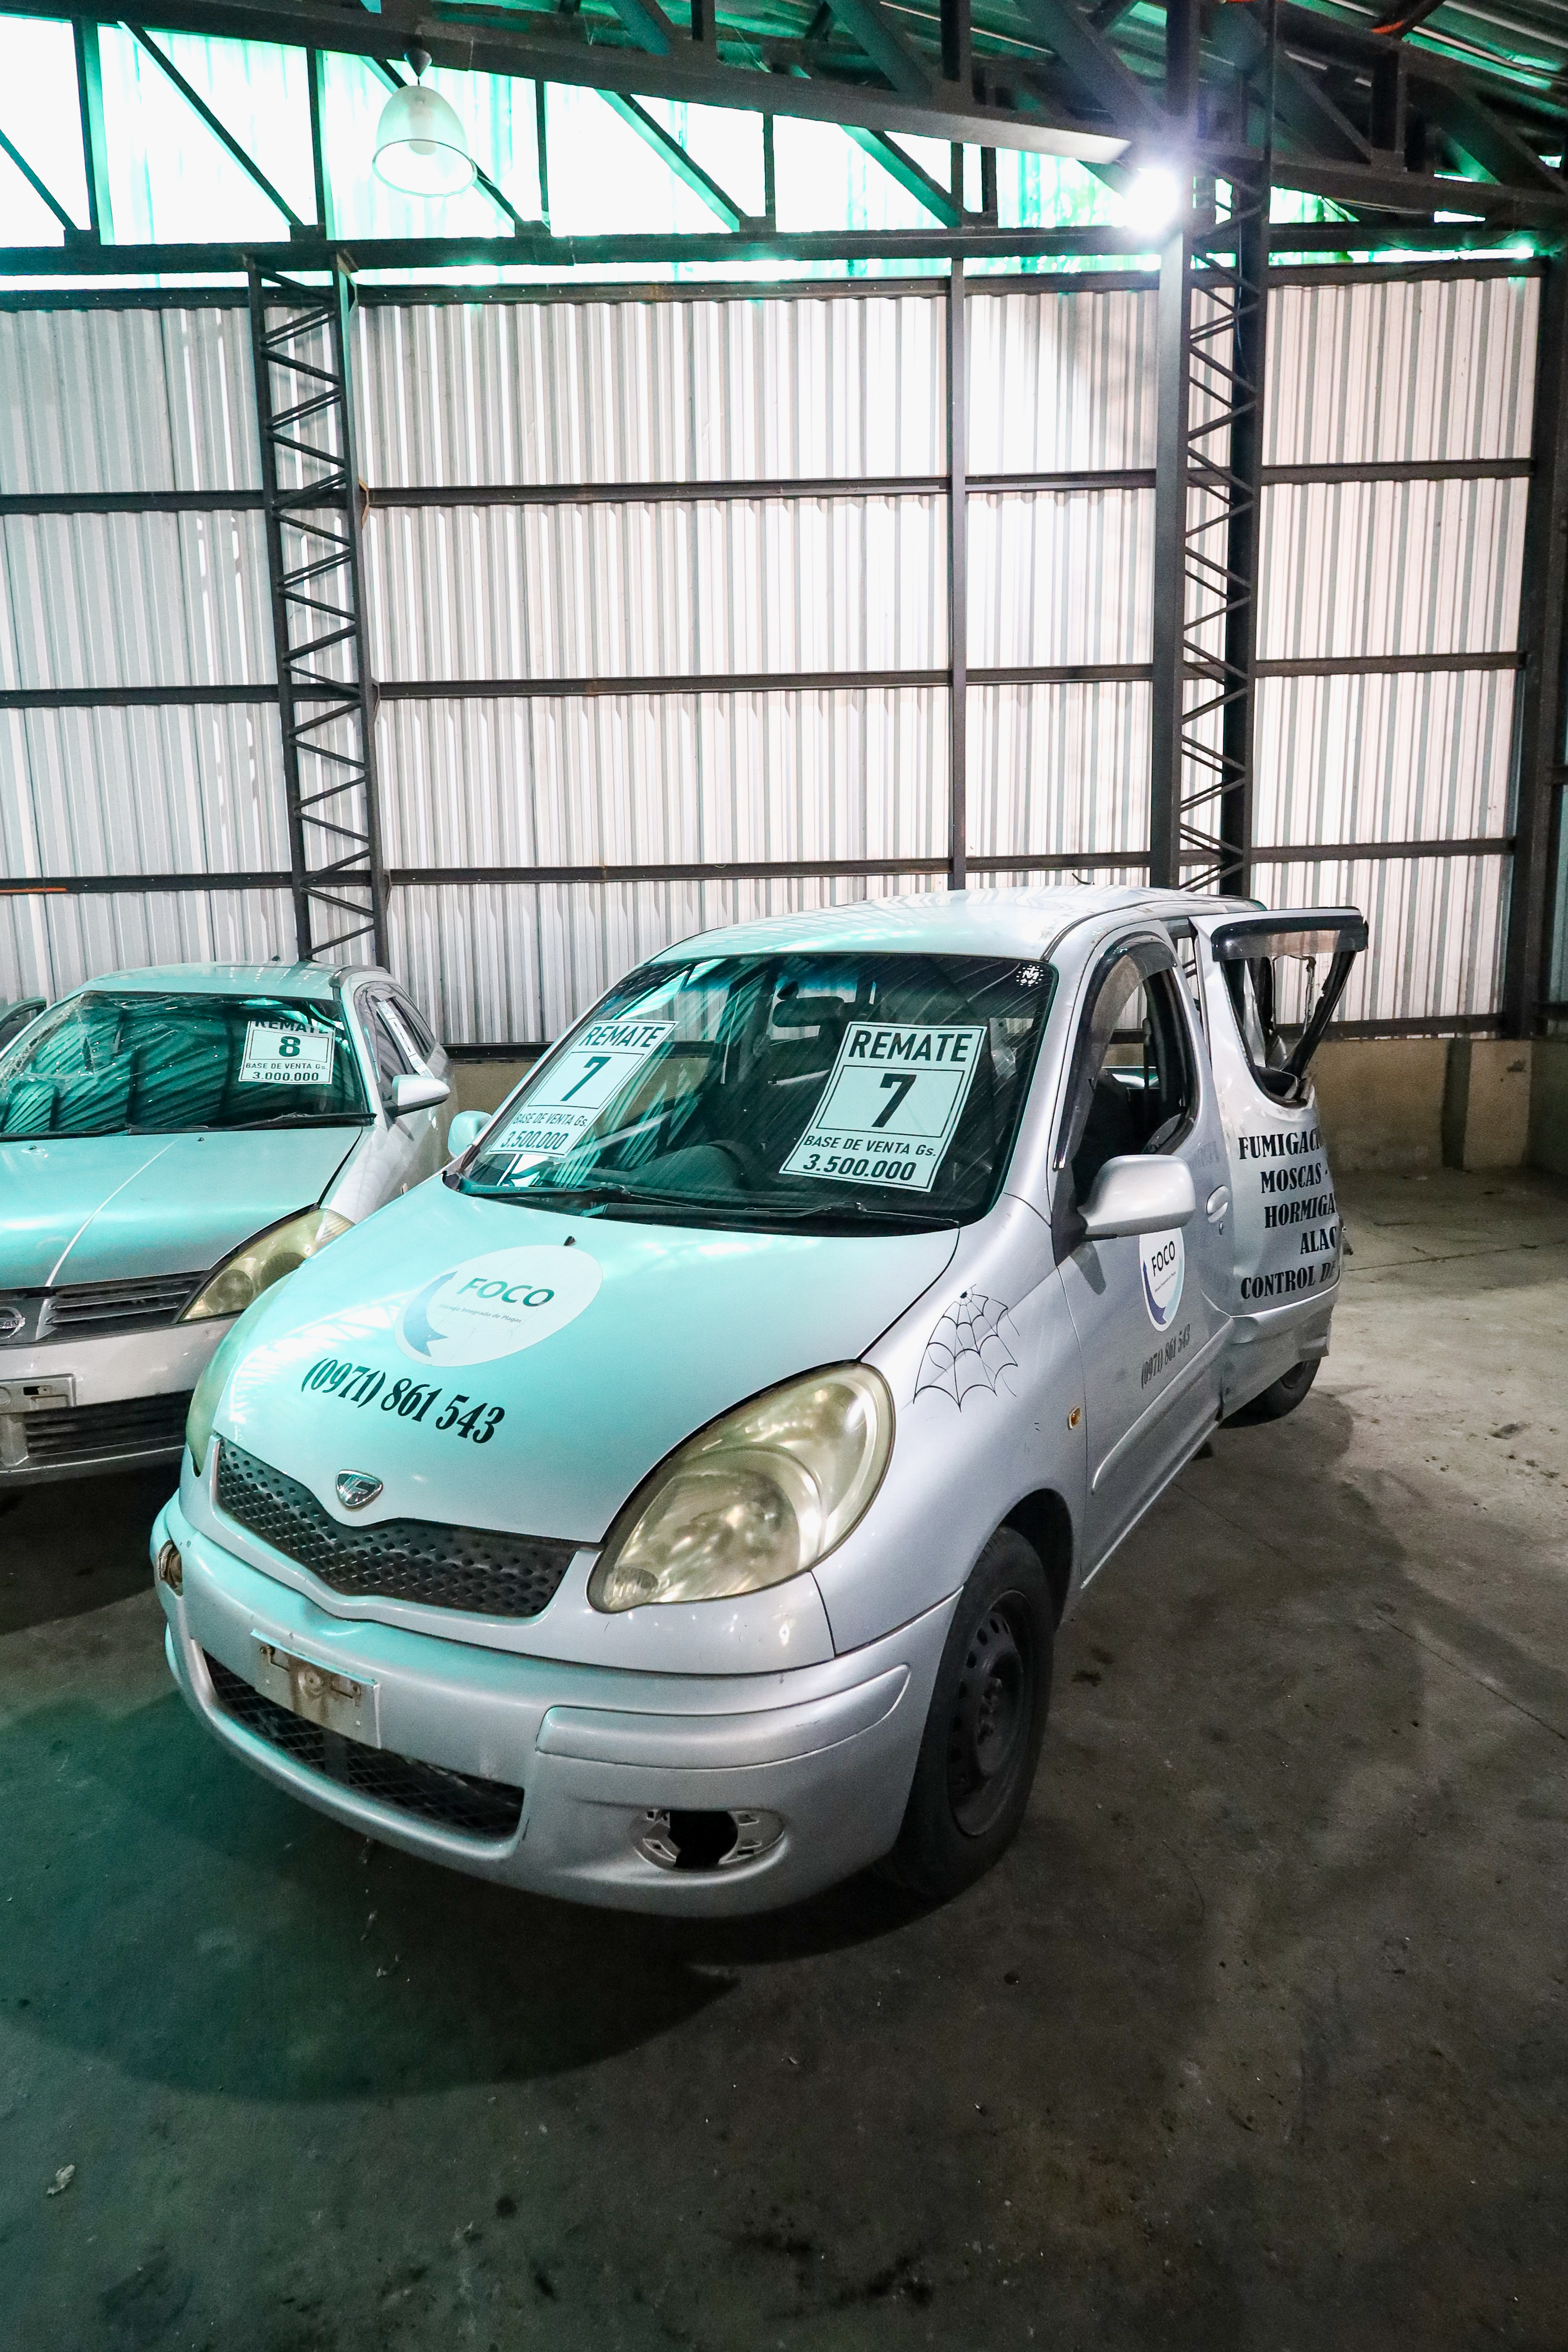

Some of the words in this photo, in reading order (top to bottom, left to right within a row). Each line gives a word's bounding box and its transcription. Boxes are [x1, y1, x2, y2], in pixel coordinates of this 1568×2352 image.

[279, 1036, 300, 1057] 8
[578, 1026, 667, 1048] REMATE
[847, 1030, 973, 1062] REMATE
[252, 1071, 319, 1081] 3.000.000
[560, 1056, 612, 1102] 7
[871, 1073, 917, 1128] 7
[513, 1113, 536, 1124] BASE
[532, 1113, 549, 1124] DE
[546, 1113, 575, 1125] VENTA
[574, 1115, 588, 1127] Gs.
[501, 1130, 569, 1150] 3.500.000
[803, 1135, 841, 1148] BASE
[842, 1138, 863, 1151] DE
[866, 1140, 910, 1154] VENTA
[915, 1144, 936, 1157] Gs.
[803, 1154, 917, 1181] 3.500.000
[1260, 1162, 1322, 1194] MOSCAS
[1151, 1240, 1175, 1277] FOCO
[457, 1277, 555, 1307] FOCO
[1240, 1265, 1316, 1299] CONTROL
[461, 1307, 491, 1316] Integrado
[501, 1315, 523, 1323] Plagas
[301, 1357, 386, 1408] (0971)
[381, 1378, 443, 1422] 861
[435, 1394, 505, 1444] 543
